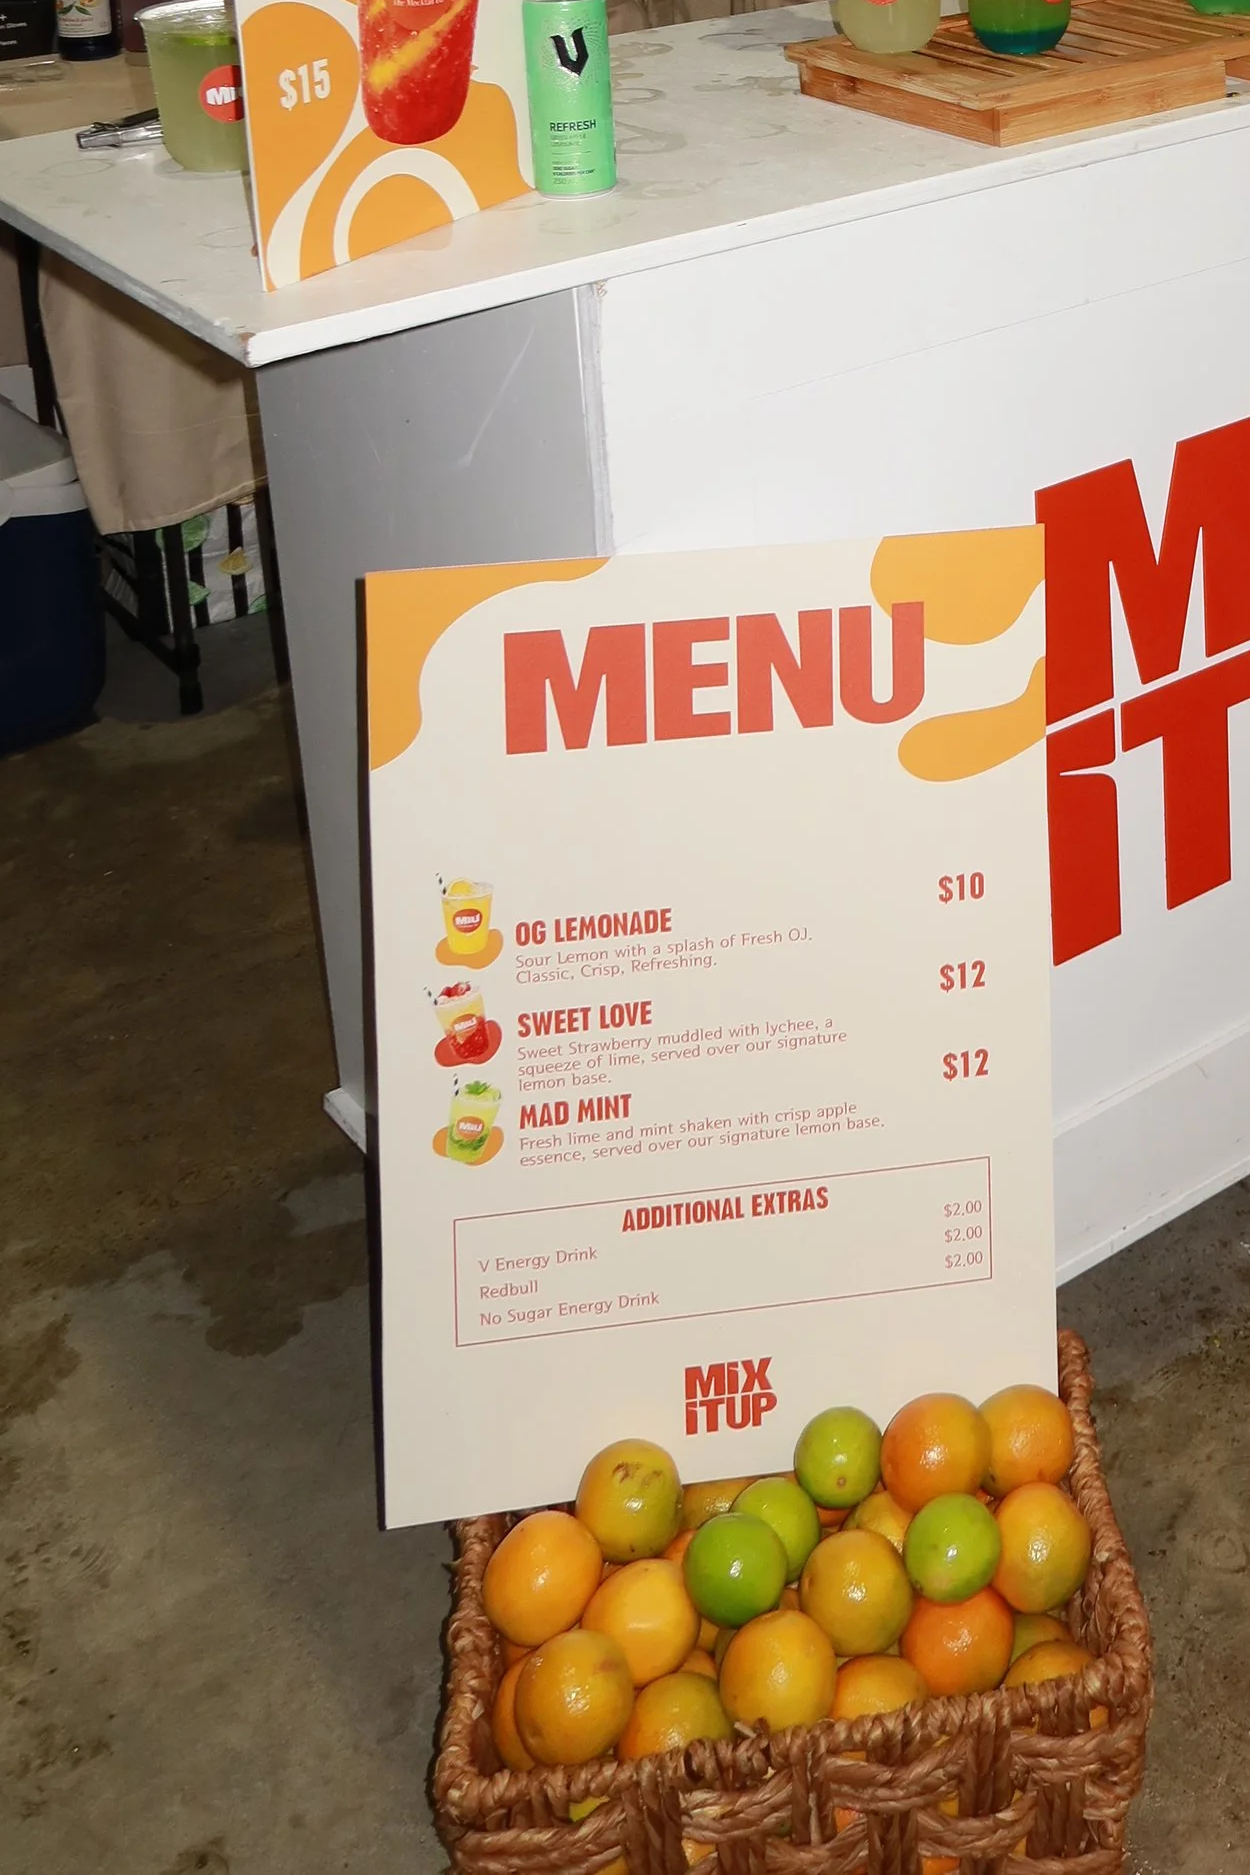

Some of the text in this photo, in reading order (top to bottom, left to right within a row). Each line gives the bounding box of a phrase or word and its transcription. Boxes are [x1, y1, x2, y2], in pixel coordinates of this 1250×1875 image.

[278, 58, 331, 112] $15
[549, 118, 597, 132] REFRESH
[503, 600, 926, 755] MENU
[938, 871, 985, 905] $10
[515, 908, 672, 947] OG LEMONADE
[516, 927, 813, 969] Sour Lemon with a splash of Fresh OJ.
[516, 954, 718, 984] Classic, Crisp, Refreshing.
[939, 960, 986, 993] $12
[517, 1000, 652, 1038] SWEET LOVE
[518, 1017, 833, 1061] Sweet Strawberry muddled with lychee, a
[518, 1031, 847, 1077] squeeze of lime, served over our signature
[519, 1072, 612, 1092] lemon base.
[942, 1048, 989, 1082] $12
[519, 1093, 632, 1130] MAD MINT
[519, 1101, 857, 1151] Fresh lime and mint shaken with crisp apple
[520, 1116, 885, 1167] essence, served over our signature lemon base.
[622, 1186, 829, 1233] ADDITIONAL EXTRAS
[944, 1200, 983, 1218] $2.00
[944, 1225, 983, 1244] $2.00
[478, 1246, 599, 1273] V Energy Drink
[945, 1251, 983, 1269] $2.00
[479, 1279, 539, 1300] Redbull
[479, 1291, 660, 1326] No Sugar Energy Drink
